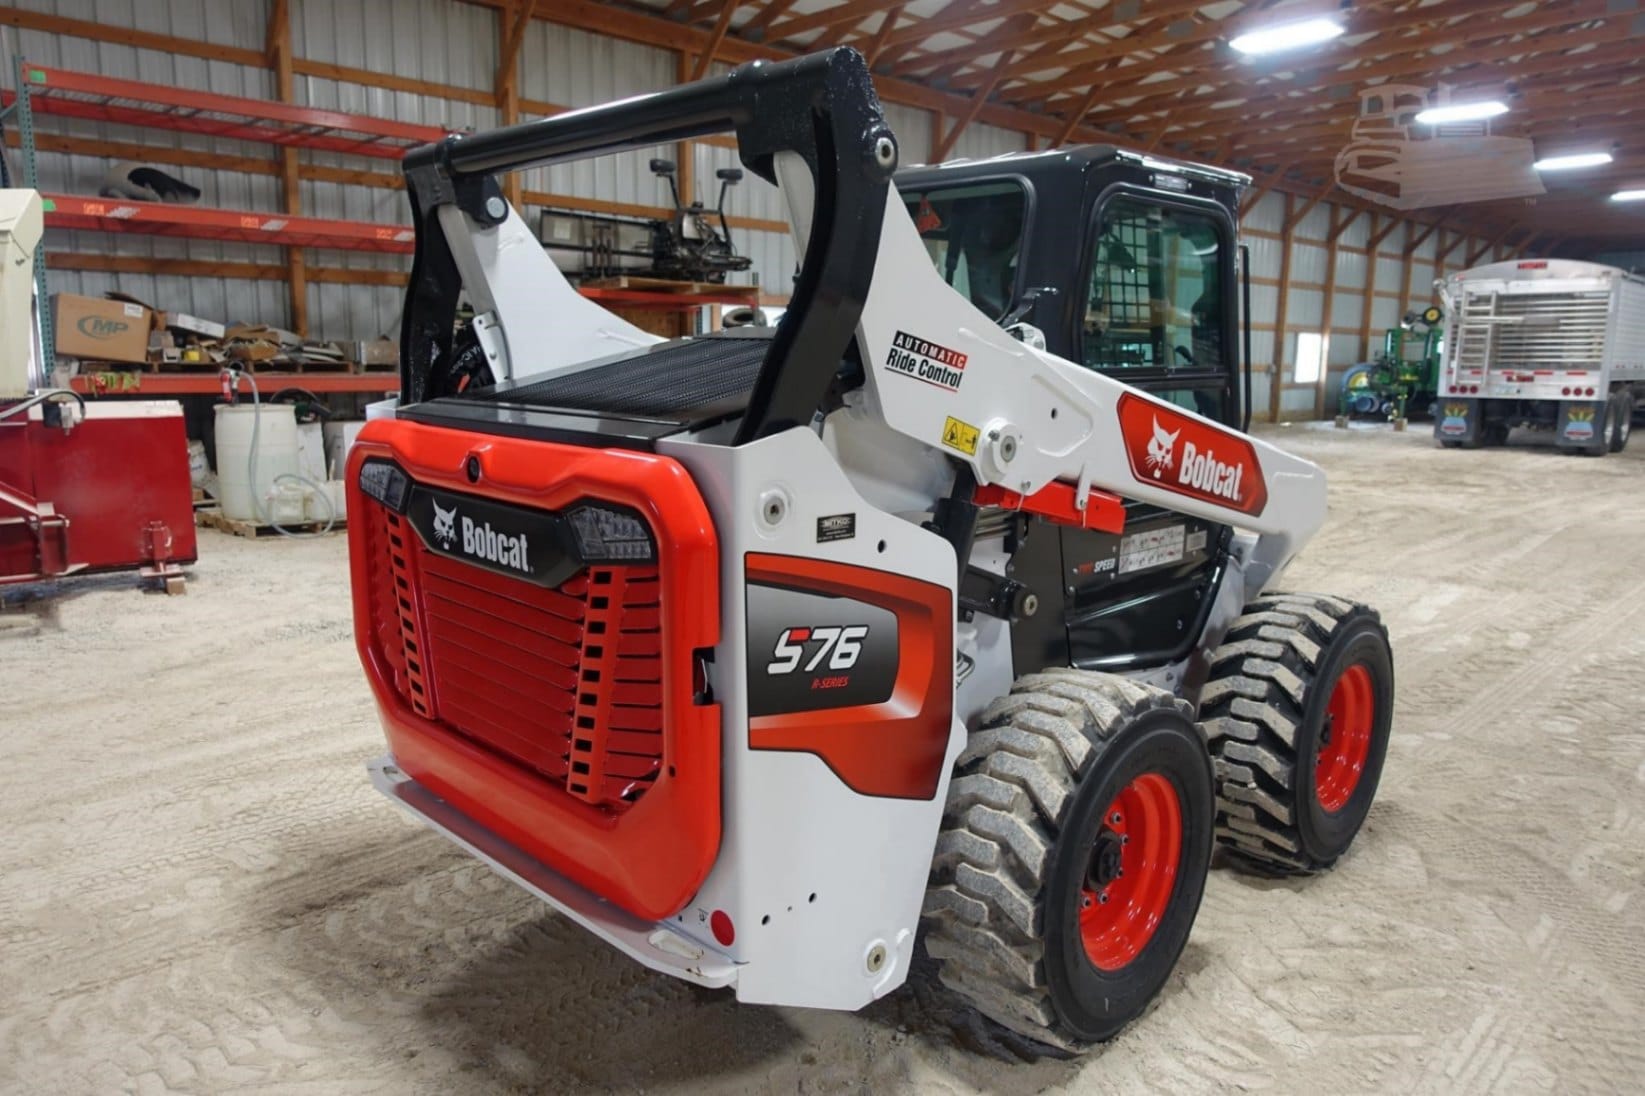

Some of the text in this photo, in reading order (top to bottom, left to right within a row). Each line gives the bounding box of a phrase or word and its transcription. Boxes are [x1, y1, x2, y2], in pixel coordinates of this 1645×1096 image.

[886, 347, 963, 388] Ride Control
[895, 334, 966, 368] AUTOMATIC
[1178, 441, 1243, 501] Bobcat
[461, 515, 530, 573] Bobcat
[1093, 557, 1116, 573] SPEED
[766, 626, 869, 675] S76
[811, 676, 850, 690] R-SERIES
